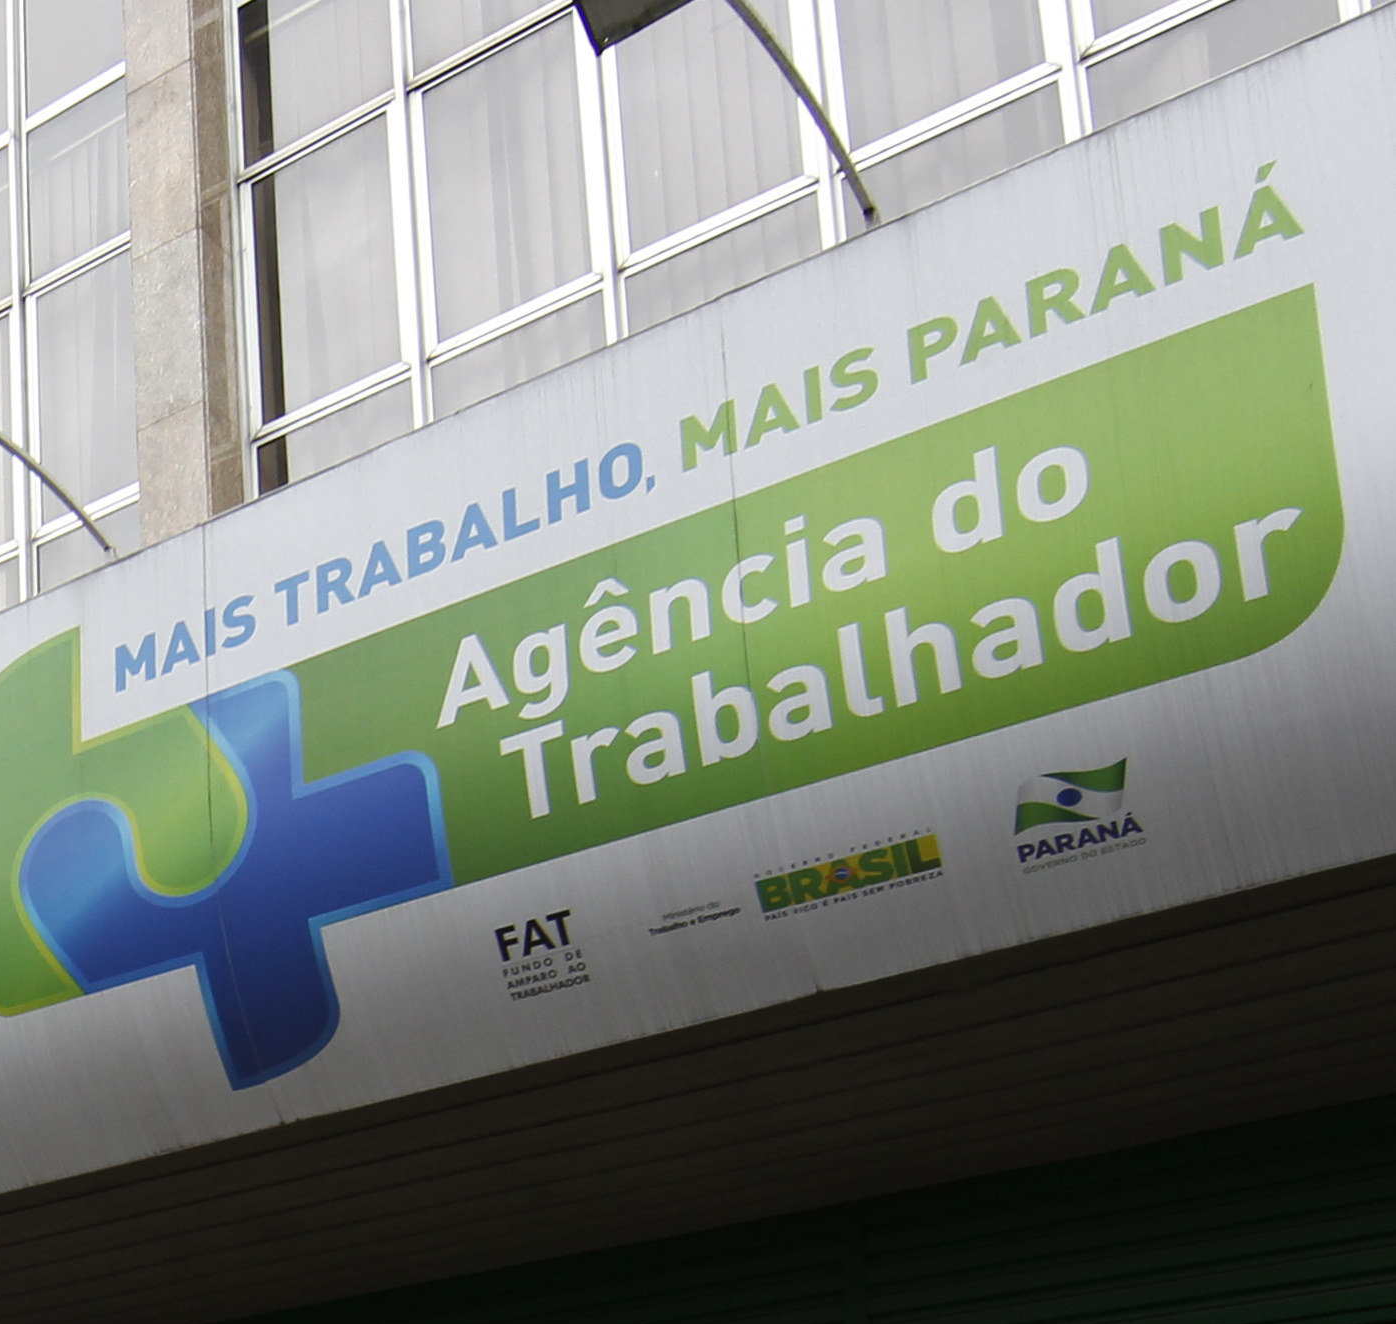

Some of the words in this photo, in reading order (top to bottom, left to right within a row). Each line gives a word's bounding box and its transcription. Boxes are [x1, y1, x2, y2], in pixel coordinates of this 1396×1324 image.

[114, 595, 256, 694] MAIS
[275, 441, 656, 628] TRABALHO,
[679, 346, 879, 473] MAIS
[906, 159, 1305, 385] PARANÁ
[435, 514, 889, 728] Agência
[931, 445, 1091, 554] do
[499, 506, 1304, 820] Trabalhador
[1017, 811, 1144, 863] PARANÁ
[1022, 854, 1078, 875] GOVERNO
[1081, 849, 1098, 860] DO
[1101, 837, 1148, 855] ESTADO
[755, 838, 942, 913] BRASIL
[862, 885, 884, 897] SEM
[889, 870, 944, 889] POBREZA
[495, 909, 571, 962] FAT
[648, 921, 688, 936] Trabalho
[697, 907, 741, 923] Emprego
[502, 957, 553, 977] FUNDO
[564, 949, 583, 962] DE
[507, 969, 558, 990] AMPARO
[568, 961, 587, 974] AO
[510, 973, 591, 1001] TRABALHADOR
